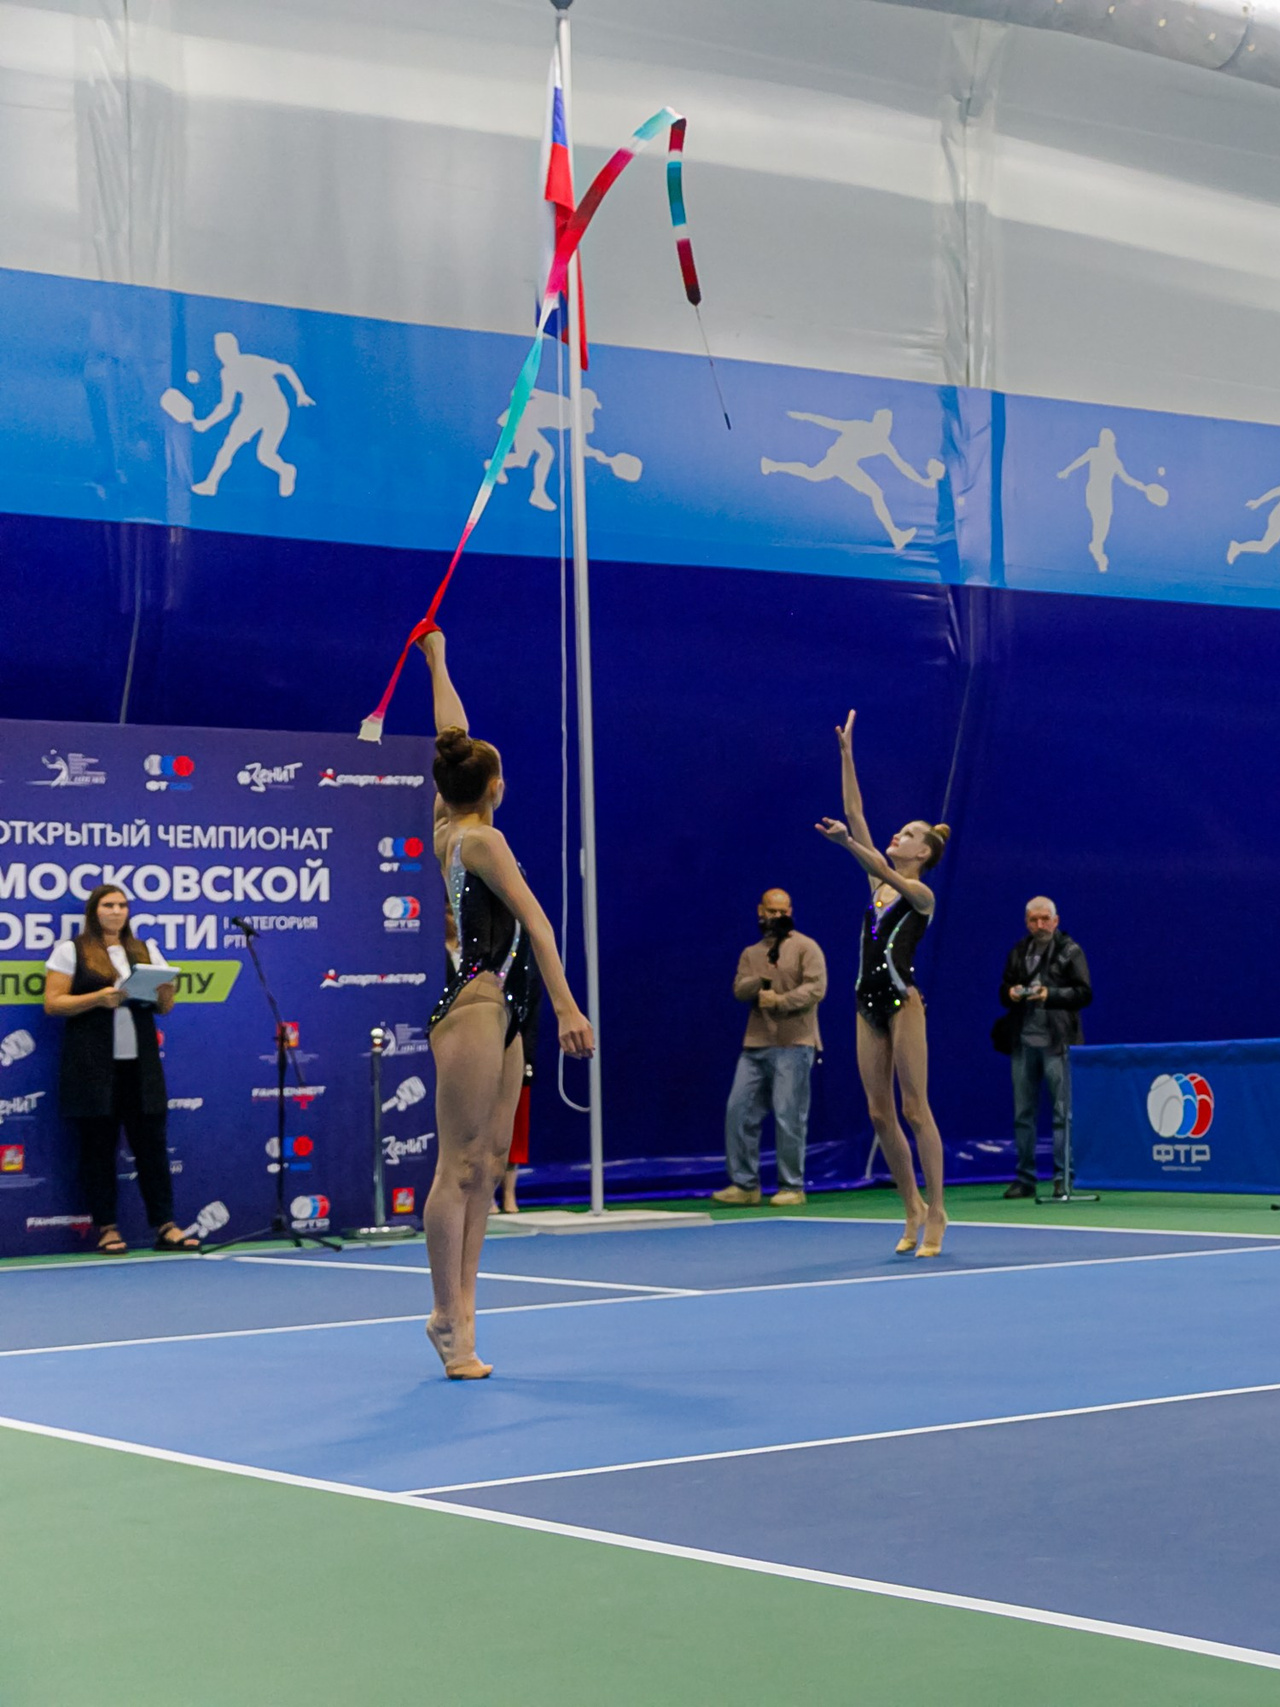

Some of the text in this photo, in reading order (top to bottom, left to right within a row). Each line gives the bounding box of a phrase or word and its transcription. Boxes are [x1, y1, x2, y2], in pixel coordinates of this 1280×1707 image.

[157, 824, 333, 850] ЧЕМПИОНАТ
[0, 858, 330, 902] МОСКОВСКОЙ
[0, 912, 217, 950] ОБЛСТИ
[231, 915, 318, 931] АТЕГОРИЯ
[1152, 1144, 1211, 1163] ФТР
